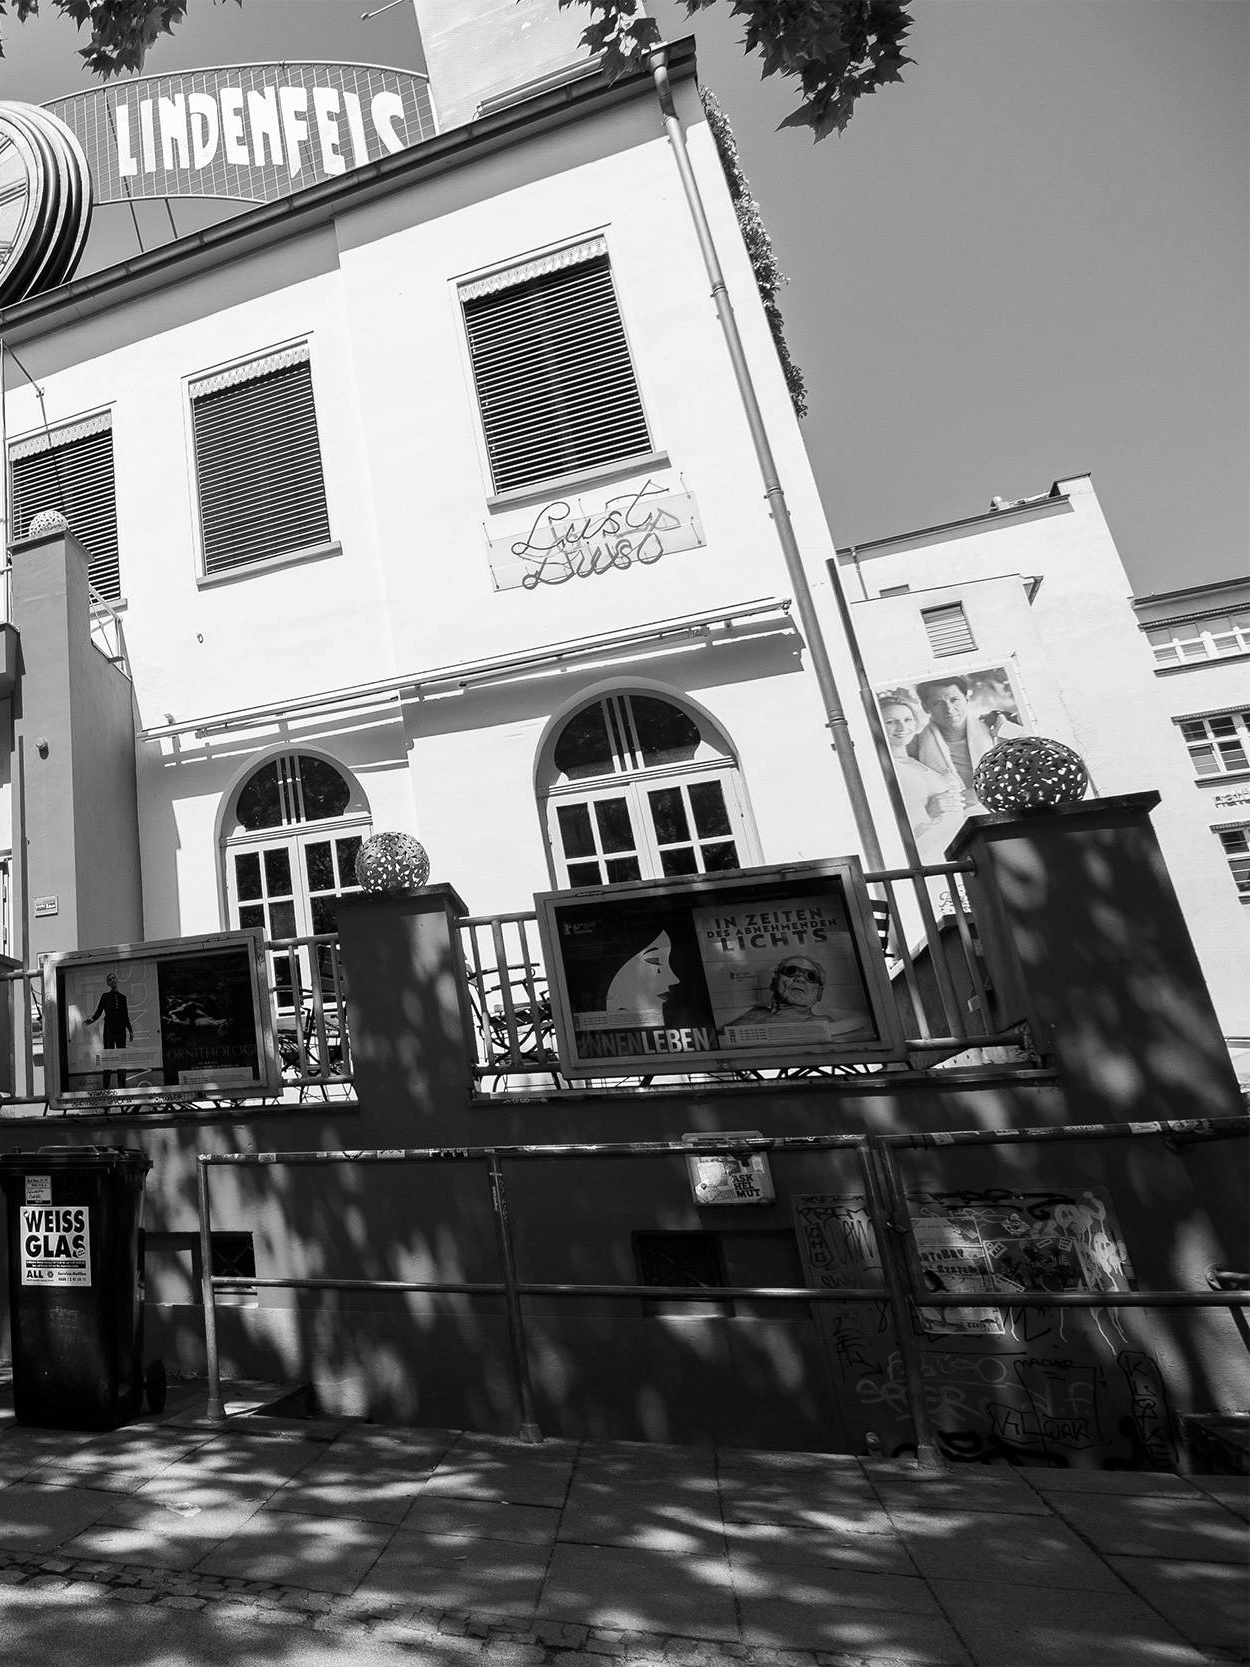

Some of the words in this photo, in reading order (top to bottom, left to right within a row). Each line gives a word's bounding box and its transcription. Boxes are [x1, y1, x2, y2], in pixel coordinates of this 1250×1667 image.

[116, 86, 405, 178] LINDENFELS
[707, 929, 731, 939] DES
[736, 918, 838, 936] ABNEHMENDEN
[715, 916, 737, 929] IN
[746, 908, 823, 926] ZEITEN
[721, 927, 828, 952] LICHTS
[167, 1044, 257, 1060] ORNITHOLOG
[732, 1174, 754, 1183] ASK
[734, 1181, 754, 1190] HEL
[736, 1189, 760, 1198] MUT
[24, 1210, 85, 1233] WEISS
[25, 1235, 85, 1258] GLAS
[27, 1270, 43, 1278] ALL
